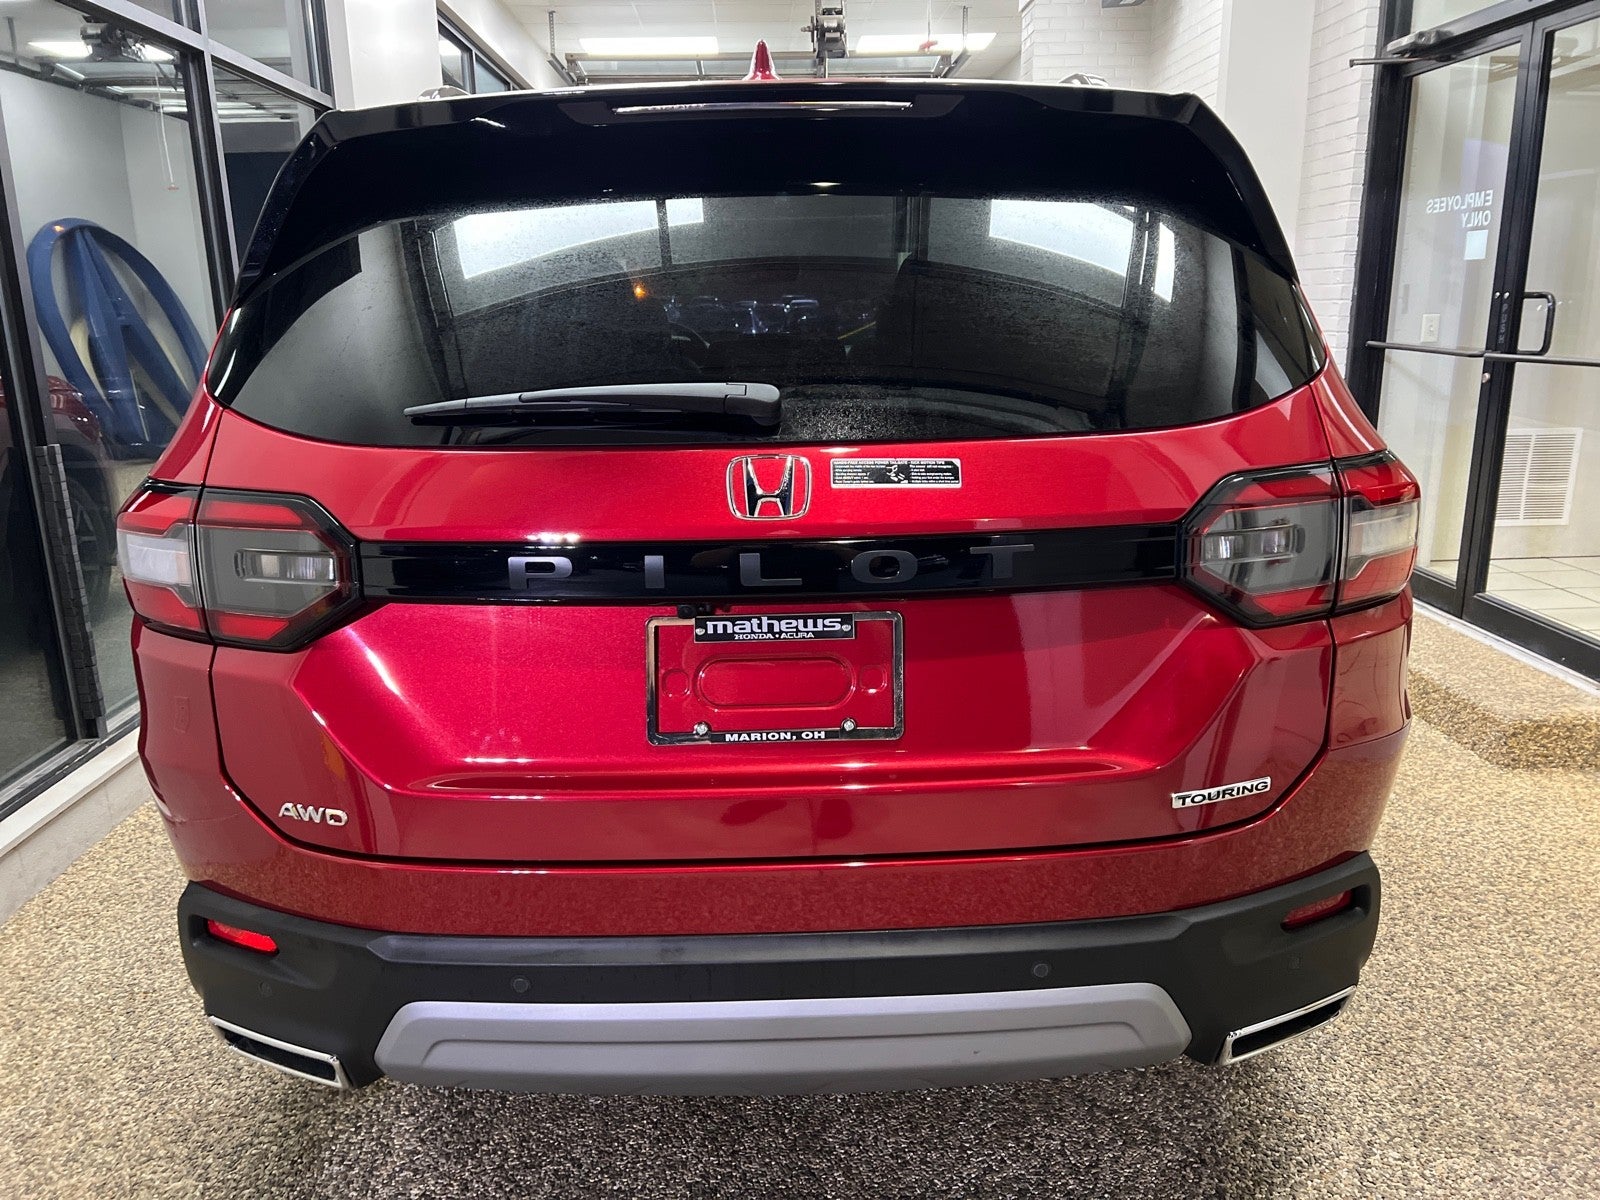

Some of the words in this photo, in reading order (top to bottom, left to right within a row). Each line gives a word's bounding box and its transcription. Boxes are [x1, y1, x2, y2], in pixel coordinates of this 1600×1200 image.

[507, 543, 1035, 590] PILOT
[706, 616, 841, 634] mathews
[725, 732, 797, 742] MARION,
[804, 731, 826, 740] OH
[1174, 780, 1269, 806] TOURING
[278, 802, 348, 826] AWD
